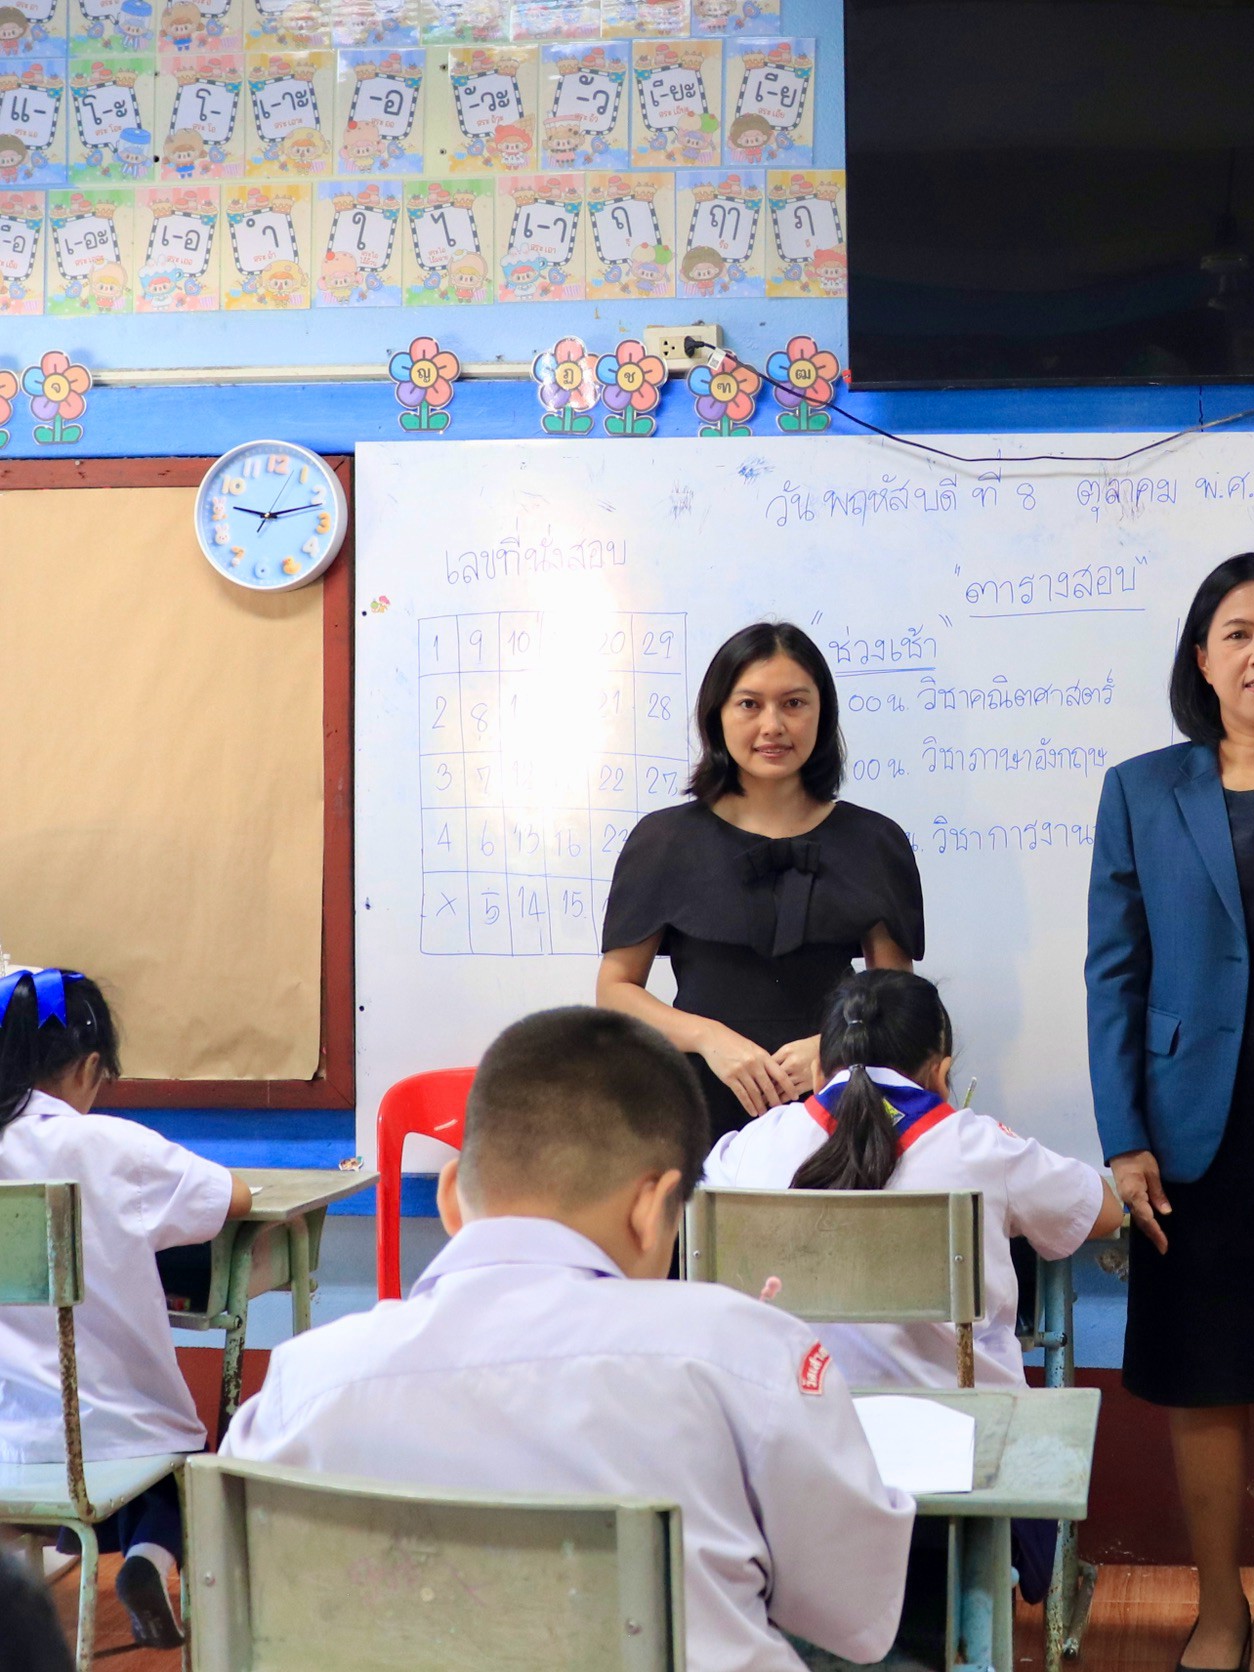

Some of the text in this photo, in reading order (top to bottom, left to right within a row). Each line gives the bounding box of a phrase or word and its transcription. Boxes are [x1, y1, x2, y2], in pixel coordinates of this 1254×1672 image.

[243, 460, 262, 478] 11
[267, 454, 290, 475] 12
[300, 465, 309, 484] 1
[222, 475, 246, 495] 10
[1016, 482, 1037, 511] 8
[1076, 477, 1178, 523] ตุลาคม
[316, 512, 331, 534] 3
[302, 536, 320, 558] 4
[433, 635, 439, 662] 1
[469, 629, 483, 665] 9
[507, 630, 531, 656] 10
[643, 630, 675, 659] 29
[432, 695, 447, 730] 2
[470, 702, 489, 734] 8
[647, 692, 672, 721] 28
[435, 763, 453, 792] 3
[476, 765, 492, 795] 7
[599, 765, 625, 792] 22
[437, 822, 453, 853] 4
[480, 820, 495, 857] 6
[518, 886, 546, 922] 14
[563, 889, 587, 919] 15
